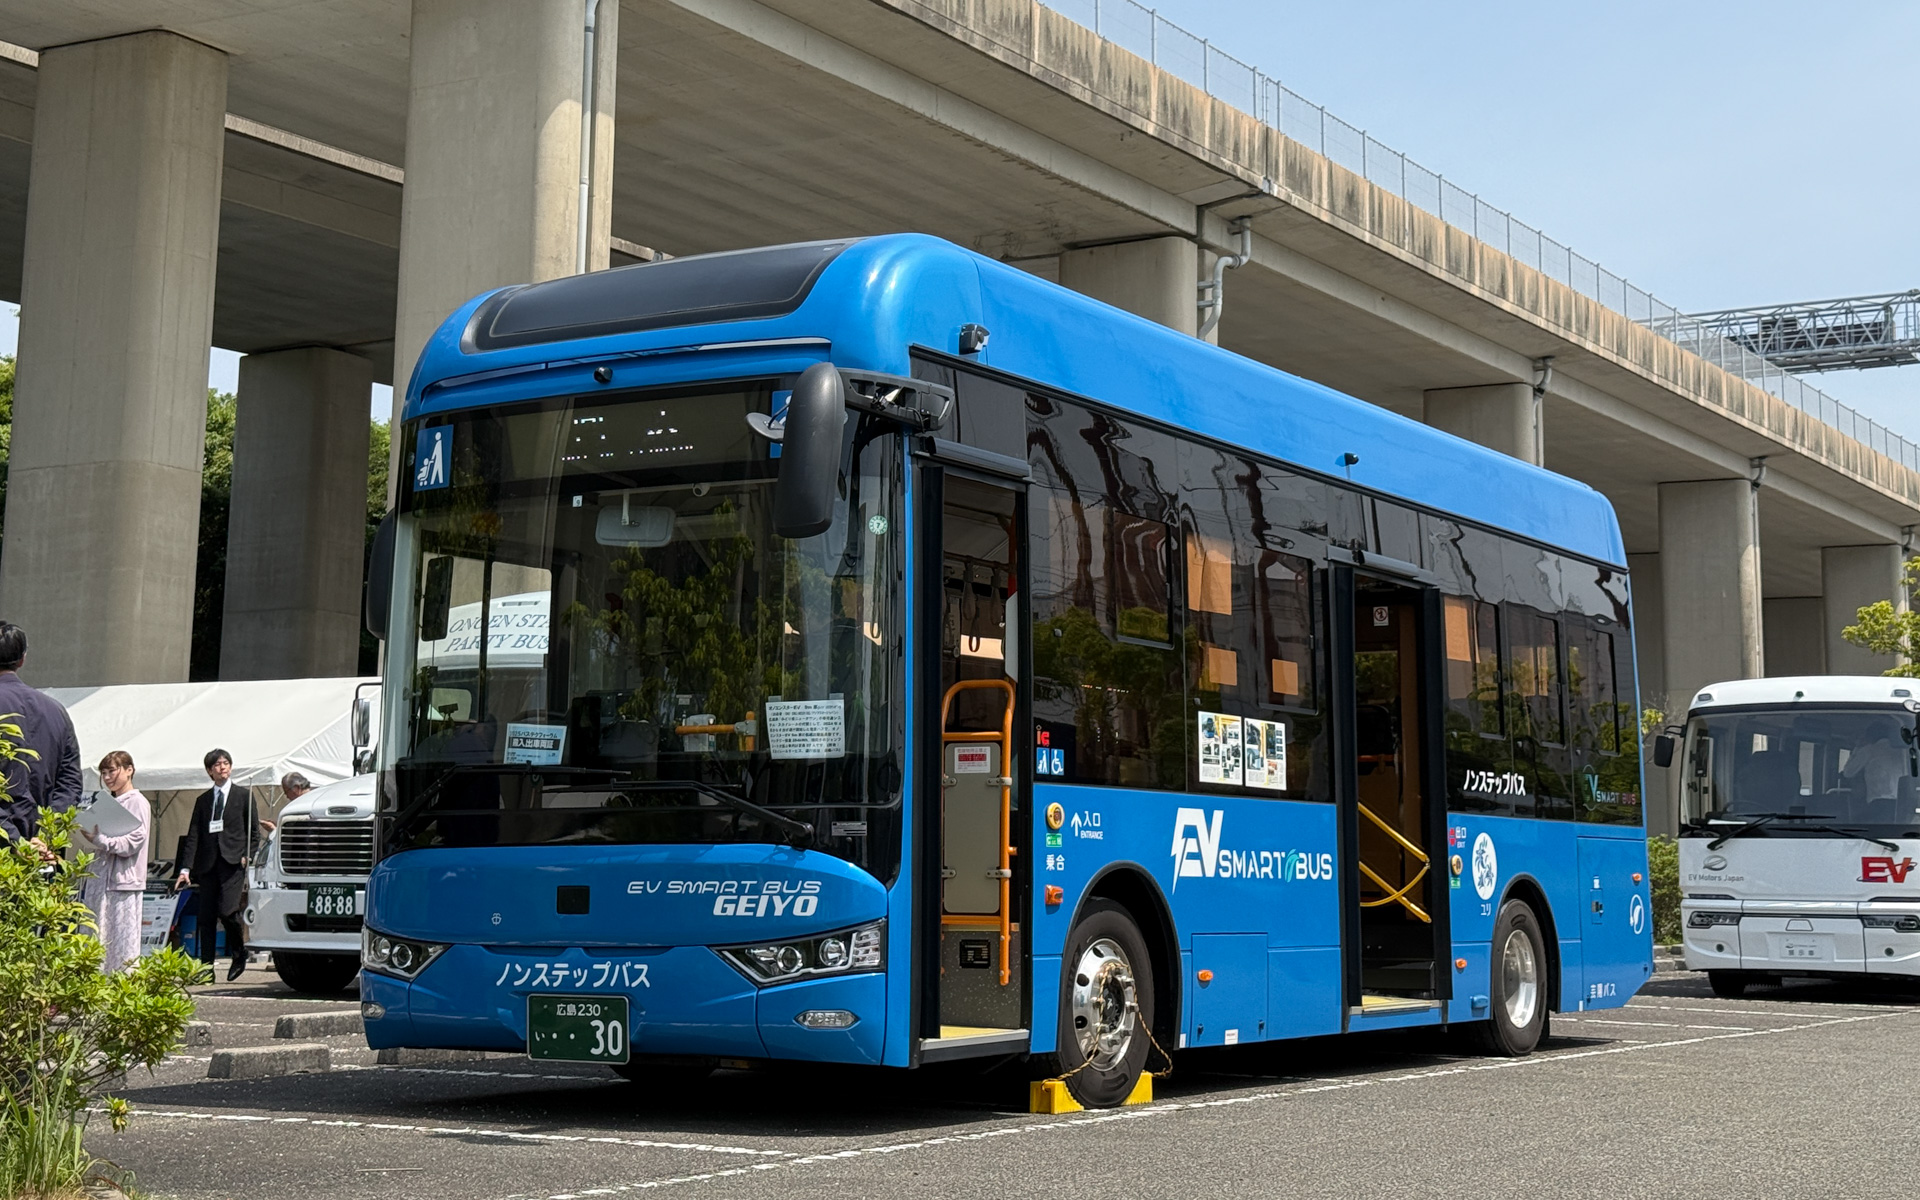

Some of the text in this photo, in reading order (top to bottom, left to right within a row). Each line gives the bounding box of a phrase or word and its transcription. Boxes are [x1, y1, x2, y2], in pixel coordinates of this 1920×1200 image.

[510, 634, 549, 649] BUS
[1463, 769, 1526, 796] ノンステップバス
[1596, 790, 1620, 804] SMART
[1622, 792, 1636, 805] BUS
[1083, 811, 1101, 827] 入口
[1080, 830, 1103, 840] ENTRANCE
[1456, 826, 1467, 839] 出口
[1046, 854, 1065, 871] 乗合
[1218, 849, 1285, 880] SMART
[1296, 852, 1333, 881] BUS
[1688, 873, 1745, 883] EV Motors Japan
[1861, 857, 1912, 884] EV
[627, 880, 822, 894] EV SMART BUS
[713, 895, 819, 917] GEIYO
[1480, 903, 1492, 917] ユリ
[496, 961, 651, 988] ノンステップバス
